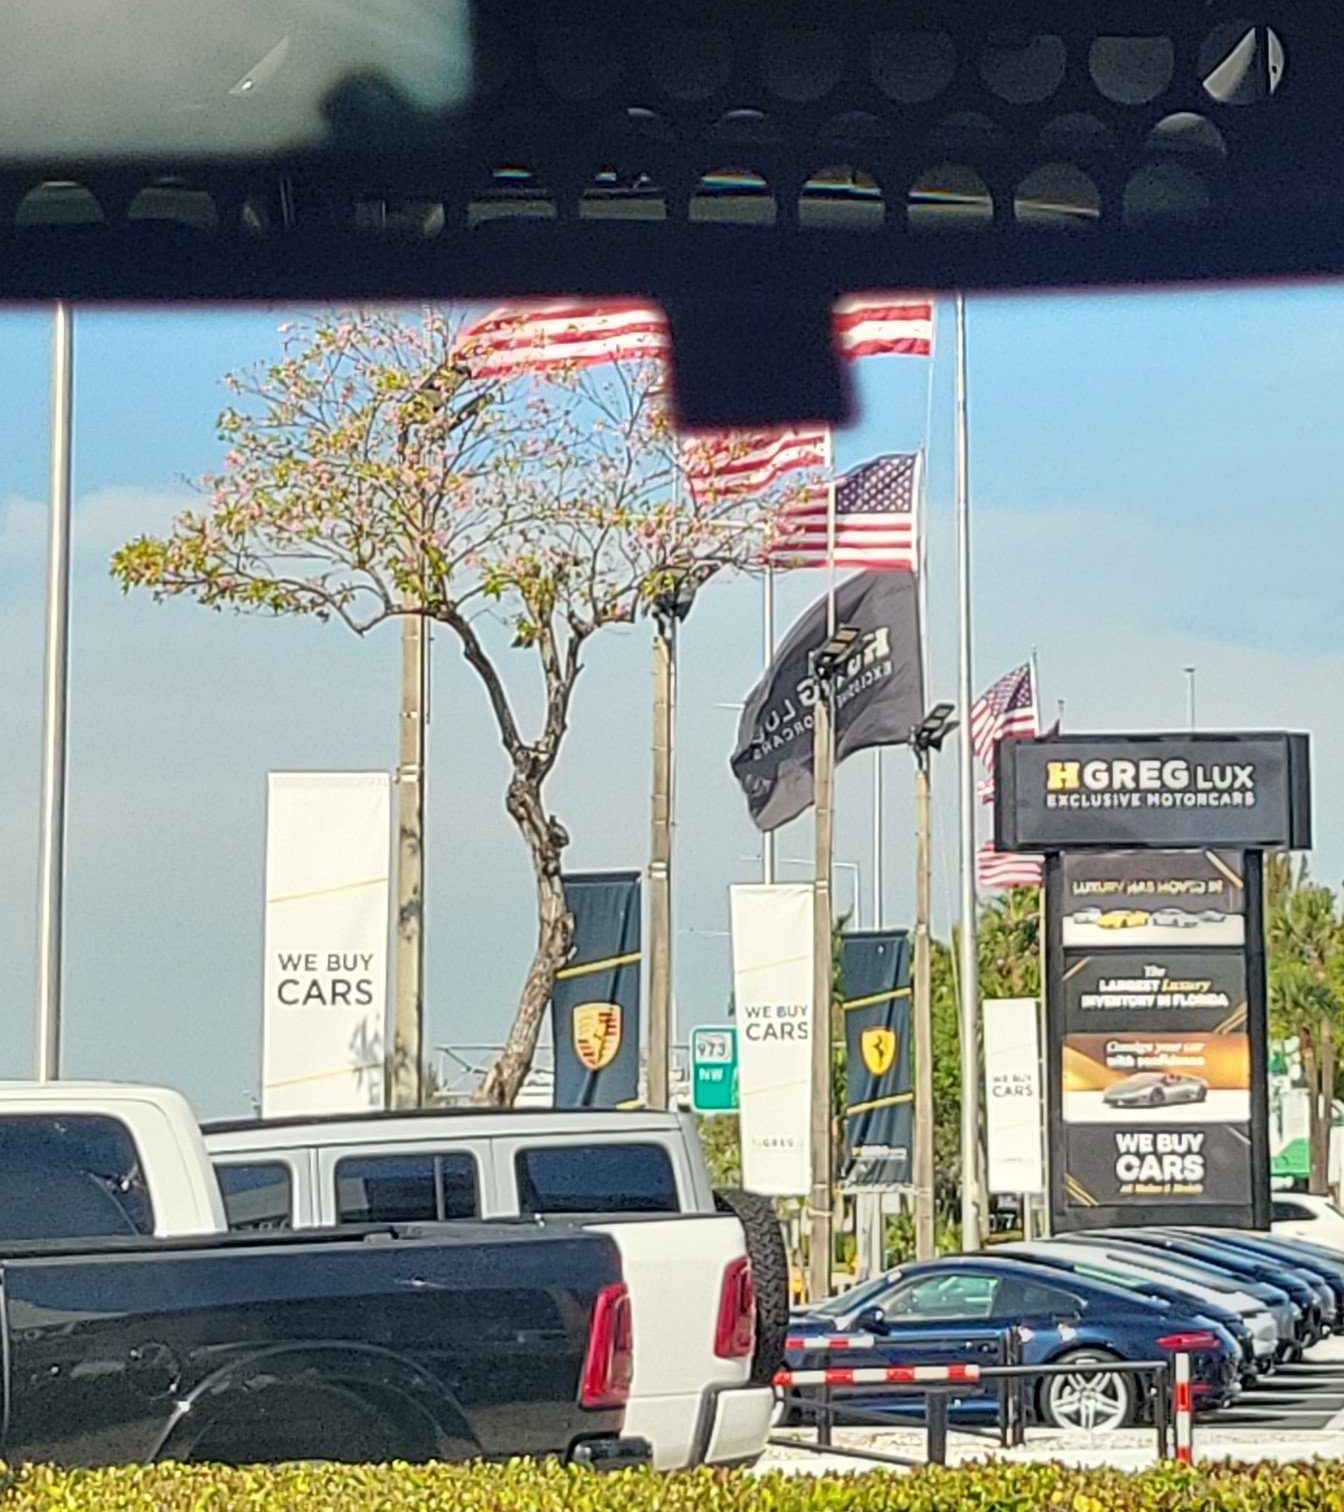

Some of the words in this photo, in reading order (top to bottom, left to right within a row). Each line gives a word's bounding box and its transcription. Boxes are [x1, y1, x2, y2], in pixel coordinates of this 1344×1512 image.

[1046, 759, 1190, 790] HGREG
[1196, 765, 1255, 790] LUX
[1046, 792, 1142, 809] EXCLUSIVE
[1147, 791, 1256, 807] MOTORCARS
[277, 953, 318, 972] WE
[327, 953, 374, 972] BUY
[277, 978, 374, 1006] CARS
[745, 1005, 771, 1019] WE
[776, 1004, 808, 1019] BUY
[745, 1021, 808, 1042] CARS
[697, 1041, 726, 1057] 973
[698, 1067, 724, 1082] NW
[992, 1085, 1034, 1098] CARS
[1116, 1133, 1154, 1153] WE
[1156, 1133, 1205, 1153] BUY
[1116, 1154, 1205, 1181] CARS
